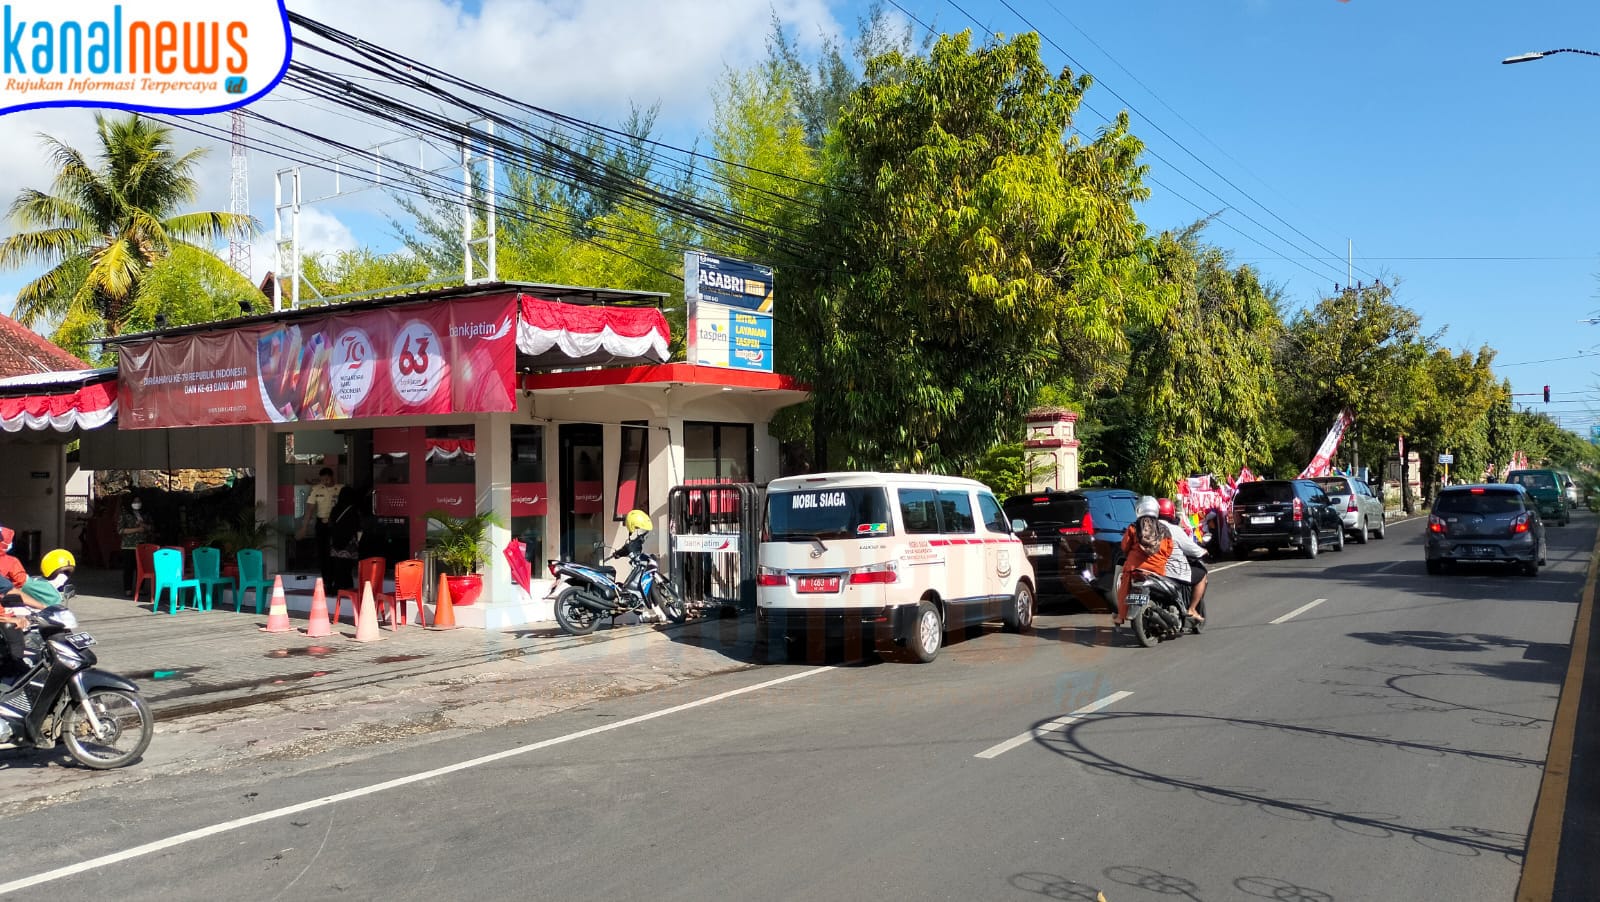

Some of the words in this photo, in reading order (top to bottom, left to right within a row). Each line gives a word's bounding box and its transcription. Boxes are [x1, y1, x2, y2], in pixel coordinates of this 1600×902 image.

[699, 269, 744, 292] ASABRI
[700, 328, 727, 343] taspen
[398, 333, 430, 376] 63
[215, 367, 247, 379] INDONESIA
[184, 385, 197, 394] DAN
[213, 382, 230, 392] BANK
[230, 379, 247, 391] JATIM
[792, 494, 818, 509] MOBIL
[820, 491, 846, 507] SIAGA
